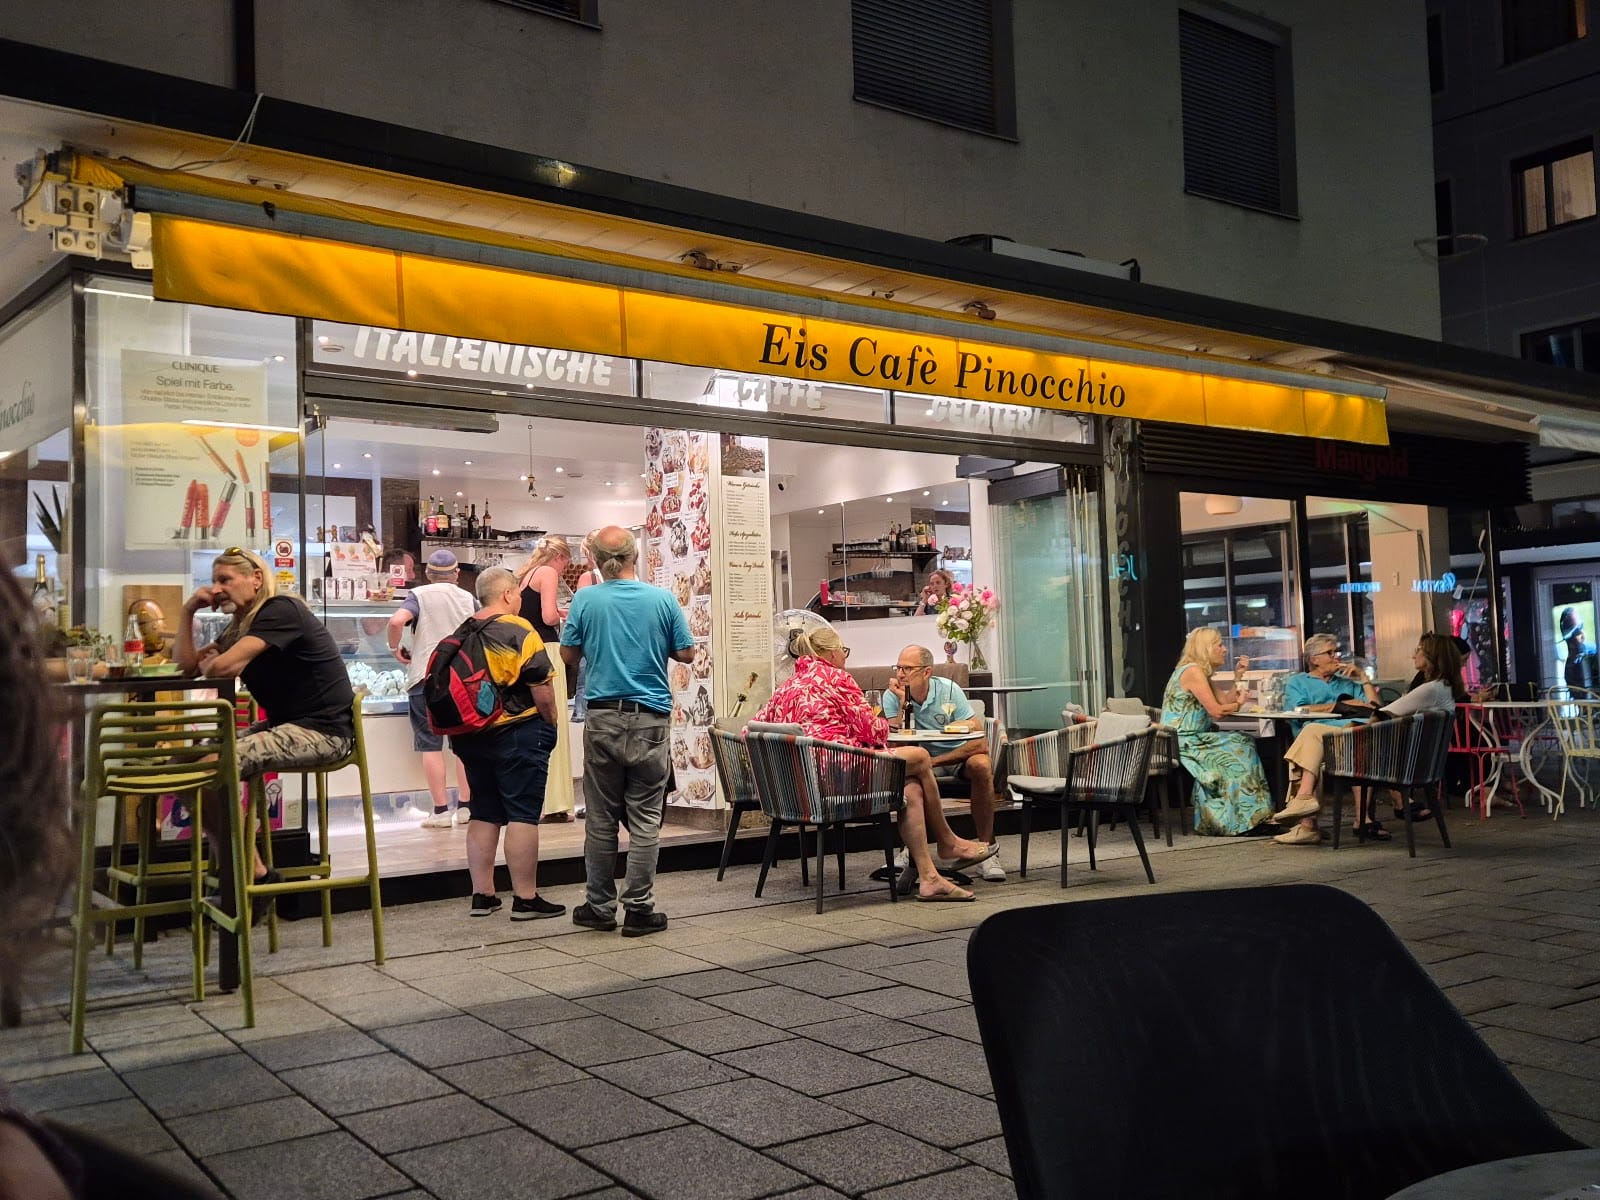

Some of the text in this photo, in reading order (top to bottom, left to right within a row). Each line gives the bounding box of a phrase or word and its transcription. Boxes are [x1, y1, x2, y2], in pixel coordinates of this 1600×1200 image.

[171, 361, 220, 374] CLINIQUE
[353, 325, 614, 386] ITALIENISCHE
[758, 322, 1126, 408] Eis Cafè Pinocchio
[156, 375, 182, 388] Spiel
[184, 378, 201, 388] mit
[1315, 441, 1408, 482] Mangold
